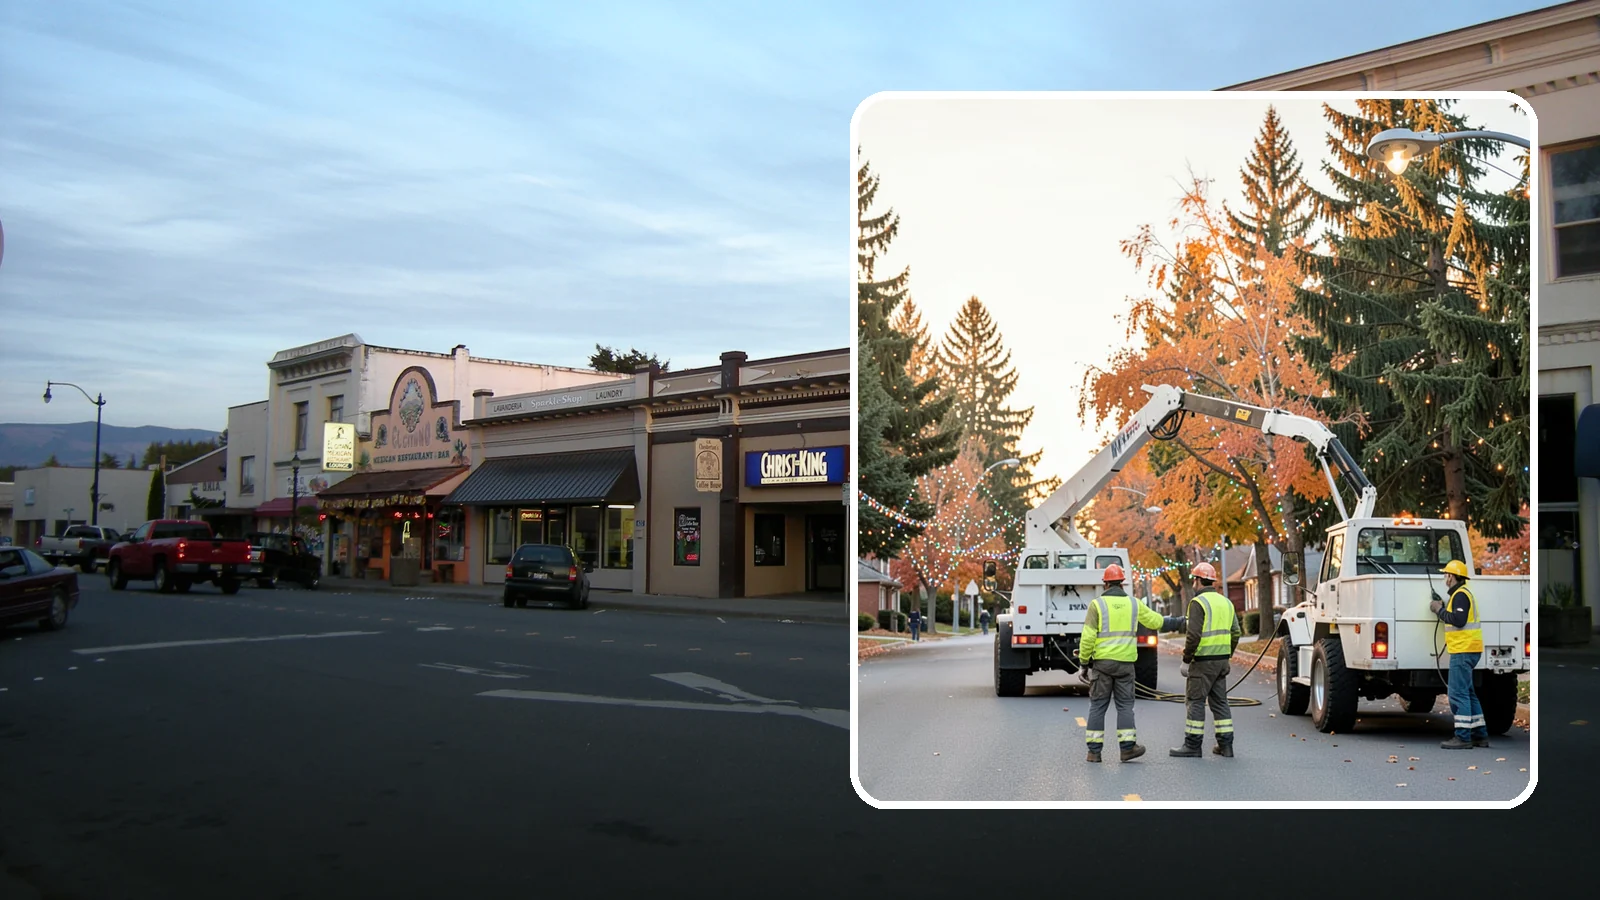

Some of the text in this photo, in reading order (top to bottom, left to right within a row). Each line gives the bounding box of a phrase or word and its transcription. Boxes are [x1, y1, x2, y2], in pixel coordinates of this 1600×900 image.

[595, 389, 623, 400] LAUNDRY
[493, 402, 522, 413] LAVANDERIA
[531, 394, 583, 410] Sparkle Shop
[373, 454, 396, 464] MEXICAN
[397, 451, 433, 462] RESTAURANT
[437, 450, 450, 459] BAR
[760, 450, 828, 478] CHRIST KING
